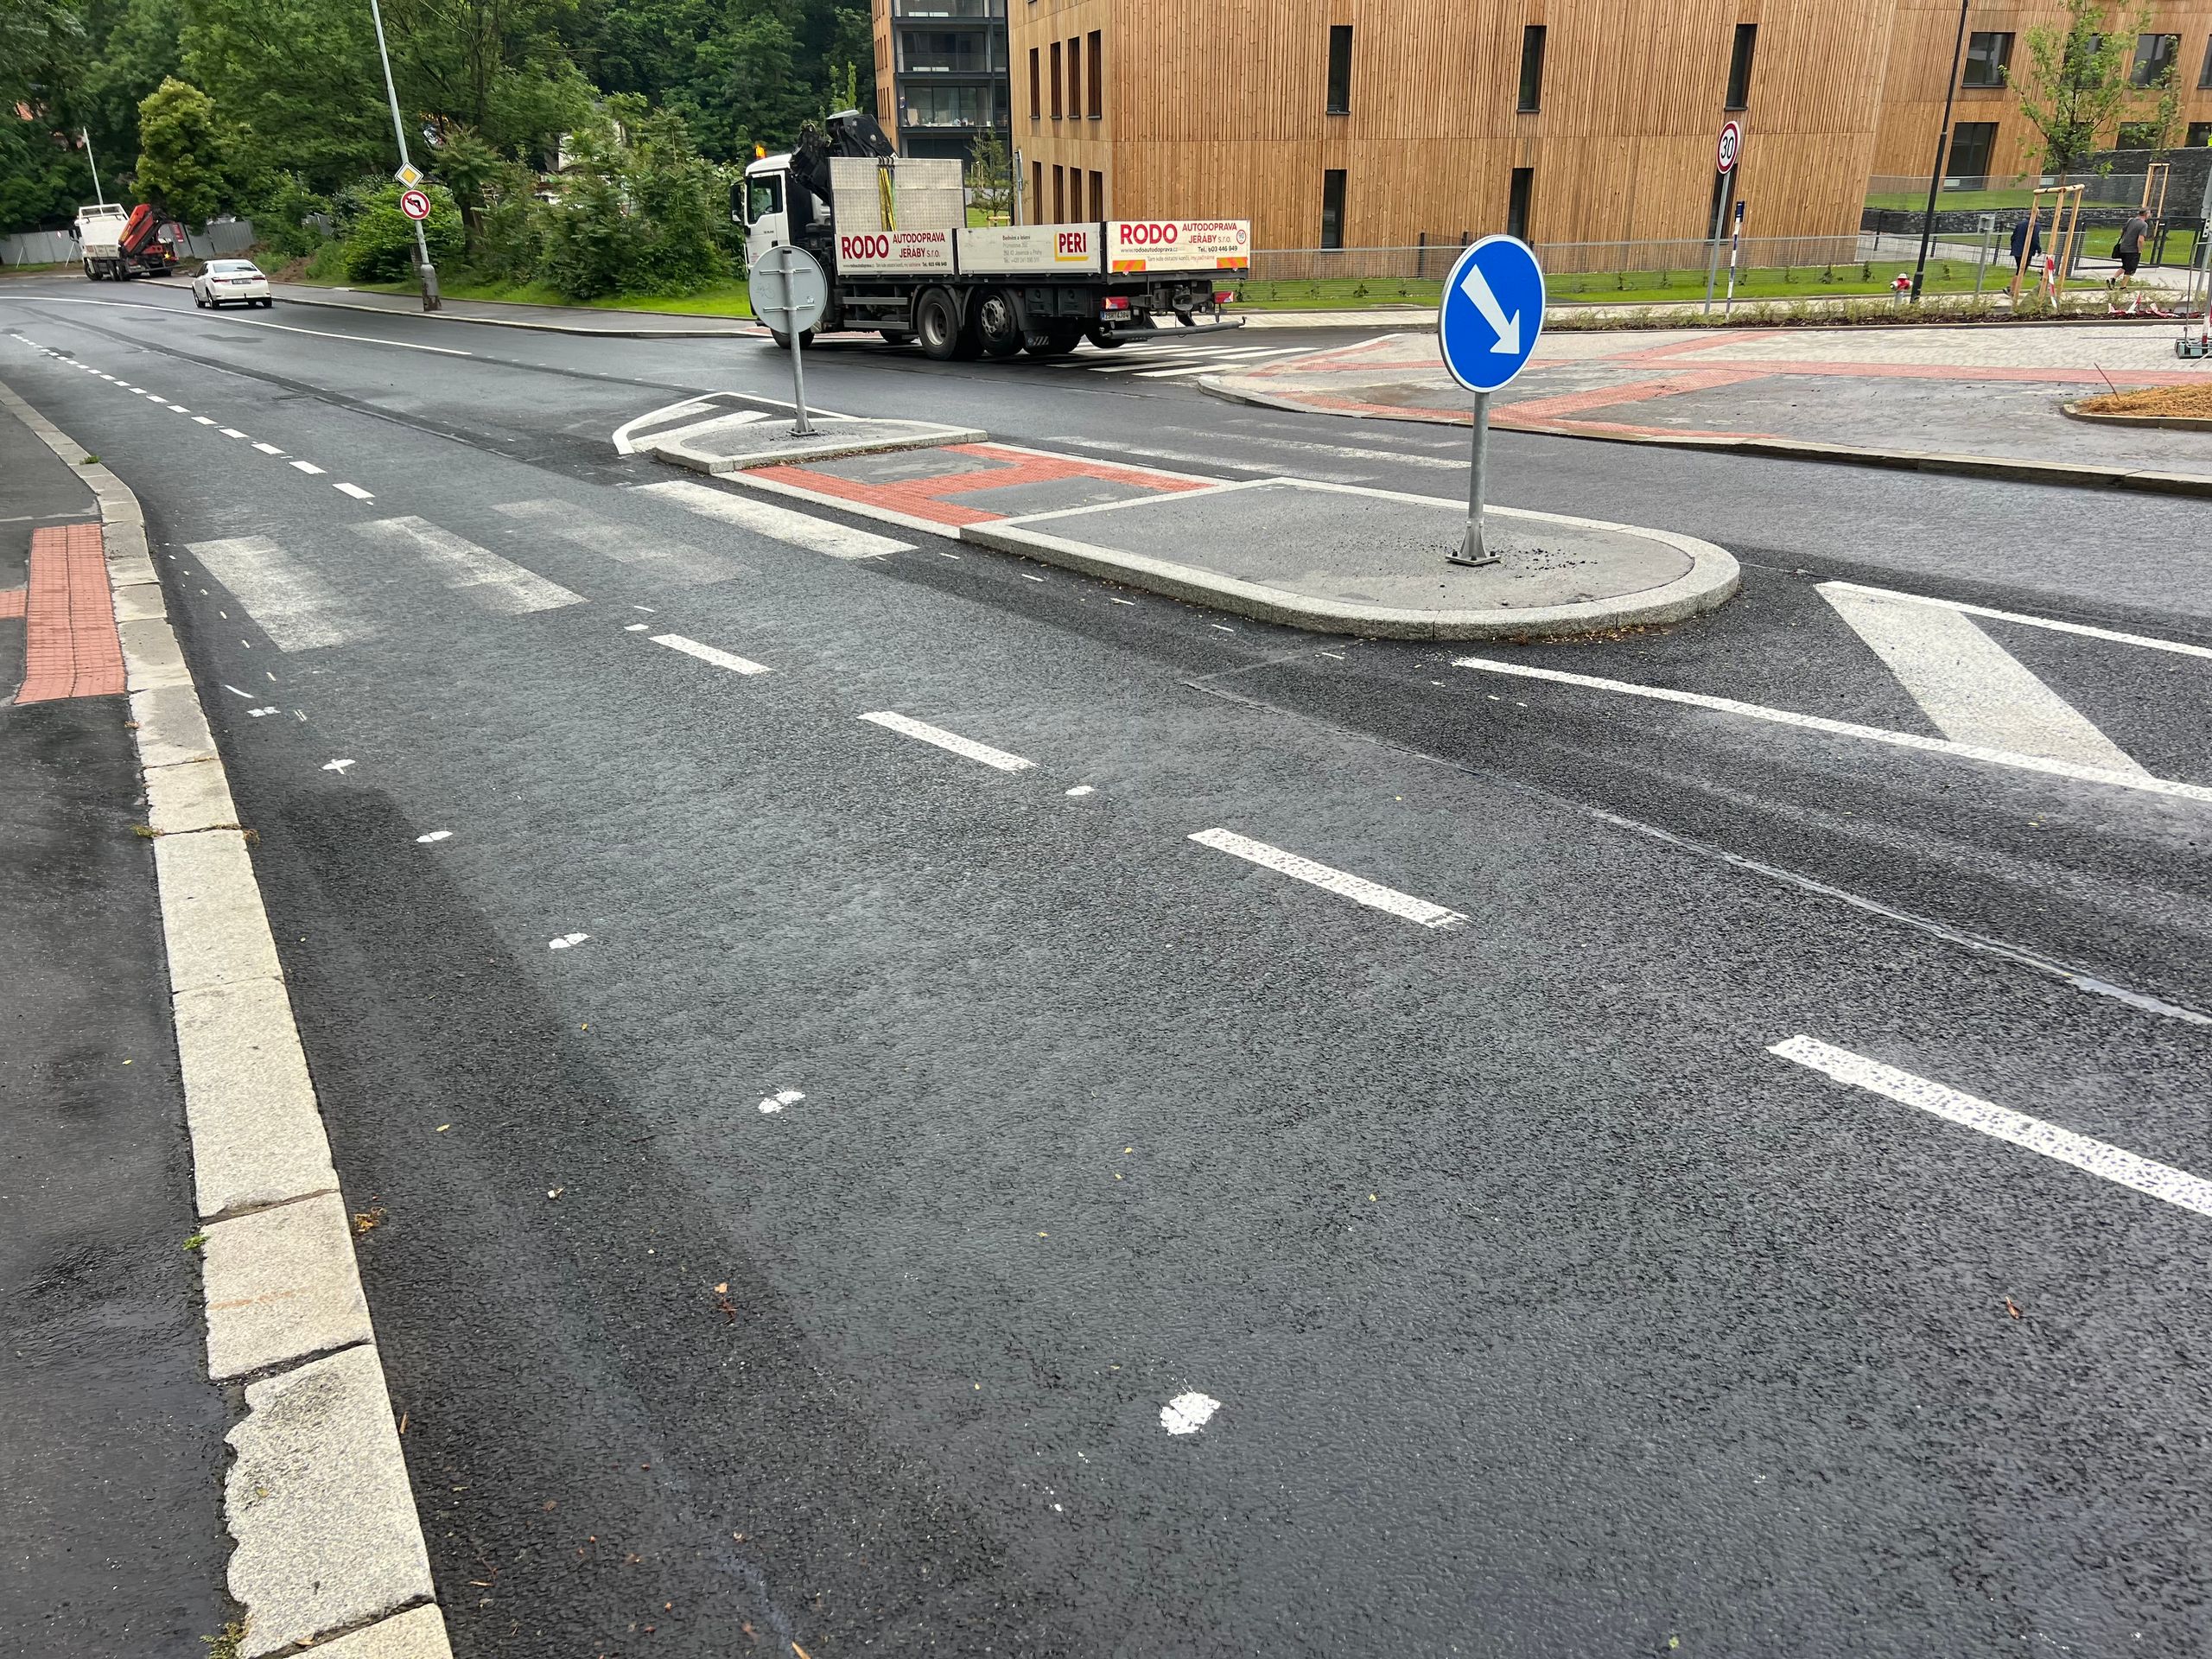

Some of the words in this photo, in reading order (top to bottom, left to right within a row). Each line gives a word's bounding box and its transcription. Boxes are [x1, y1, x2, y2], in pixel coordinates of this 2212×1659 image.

[1720, 136, 1733, 159] 30
[1120, 223, 1178, 245] RODO
[1182, 222, 1237, 232] AUTODOPRAVA
[893, 232, 945, 244] AUTODOPRAVA
[1058, 232, 1086, 253] PERI
[1188, 233, 1217, 244] JEŘÁBY
[842, 234, 889, 259] RODO
[899, 245, 925, 257] JEŘÁBY
